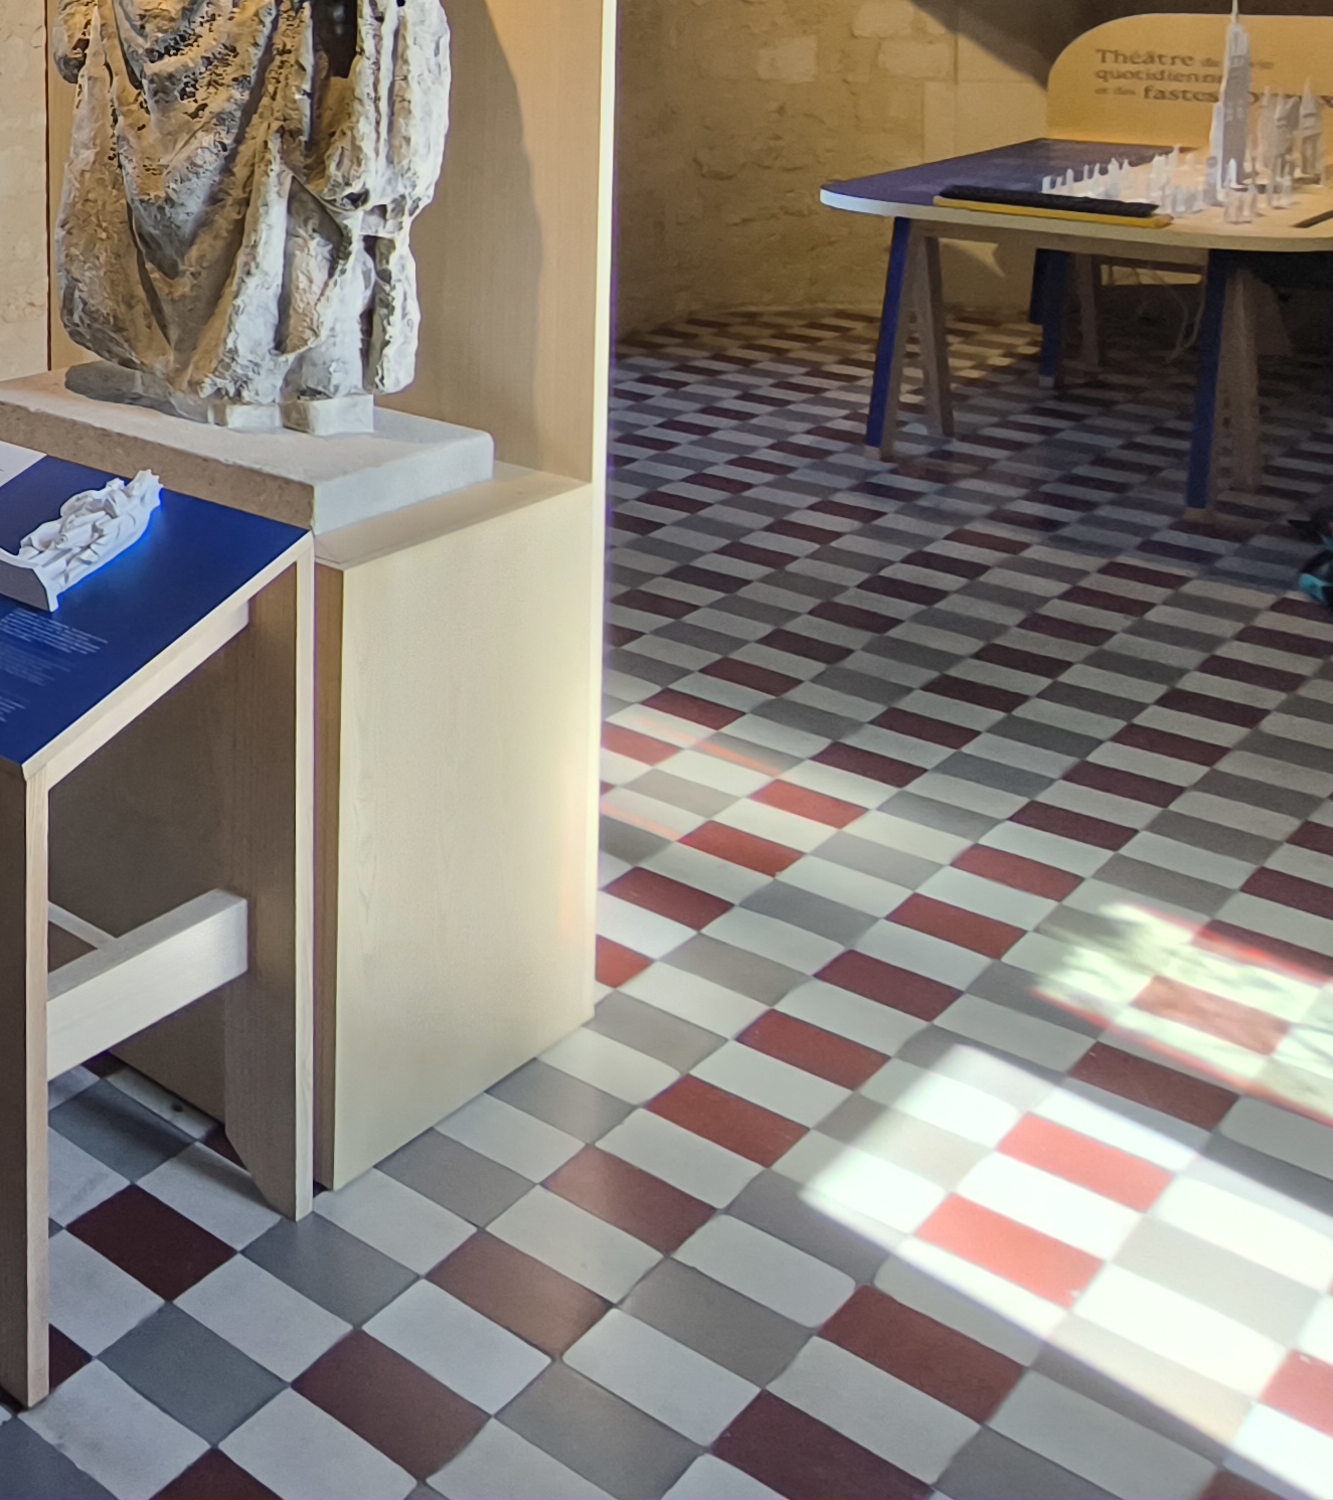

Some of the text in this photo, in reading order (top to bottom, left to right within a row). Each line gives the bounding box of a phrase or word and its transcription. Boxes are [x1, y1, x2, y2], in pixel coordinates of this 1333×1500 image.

[1095, 48, 1195, 68] Théâtre
[1096, 69, 1224, 84] quotidienn
[1144, 85, 1220, 104] fastes
